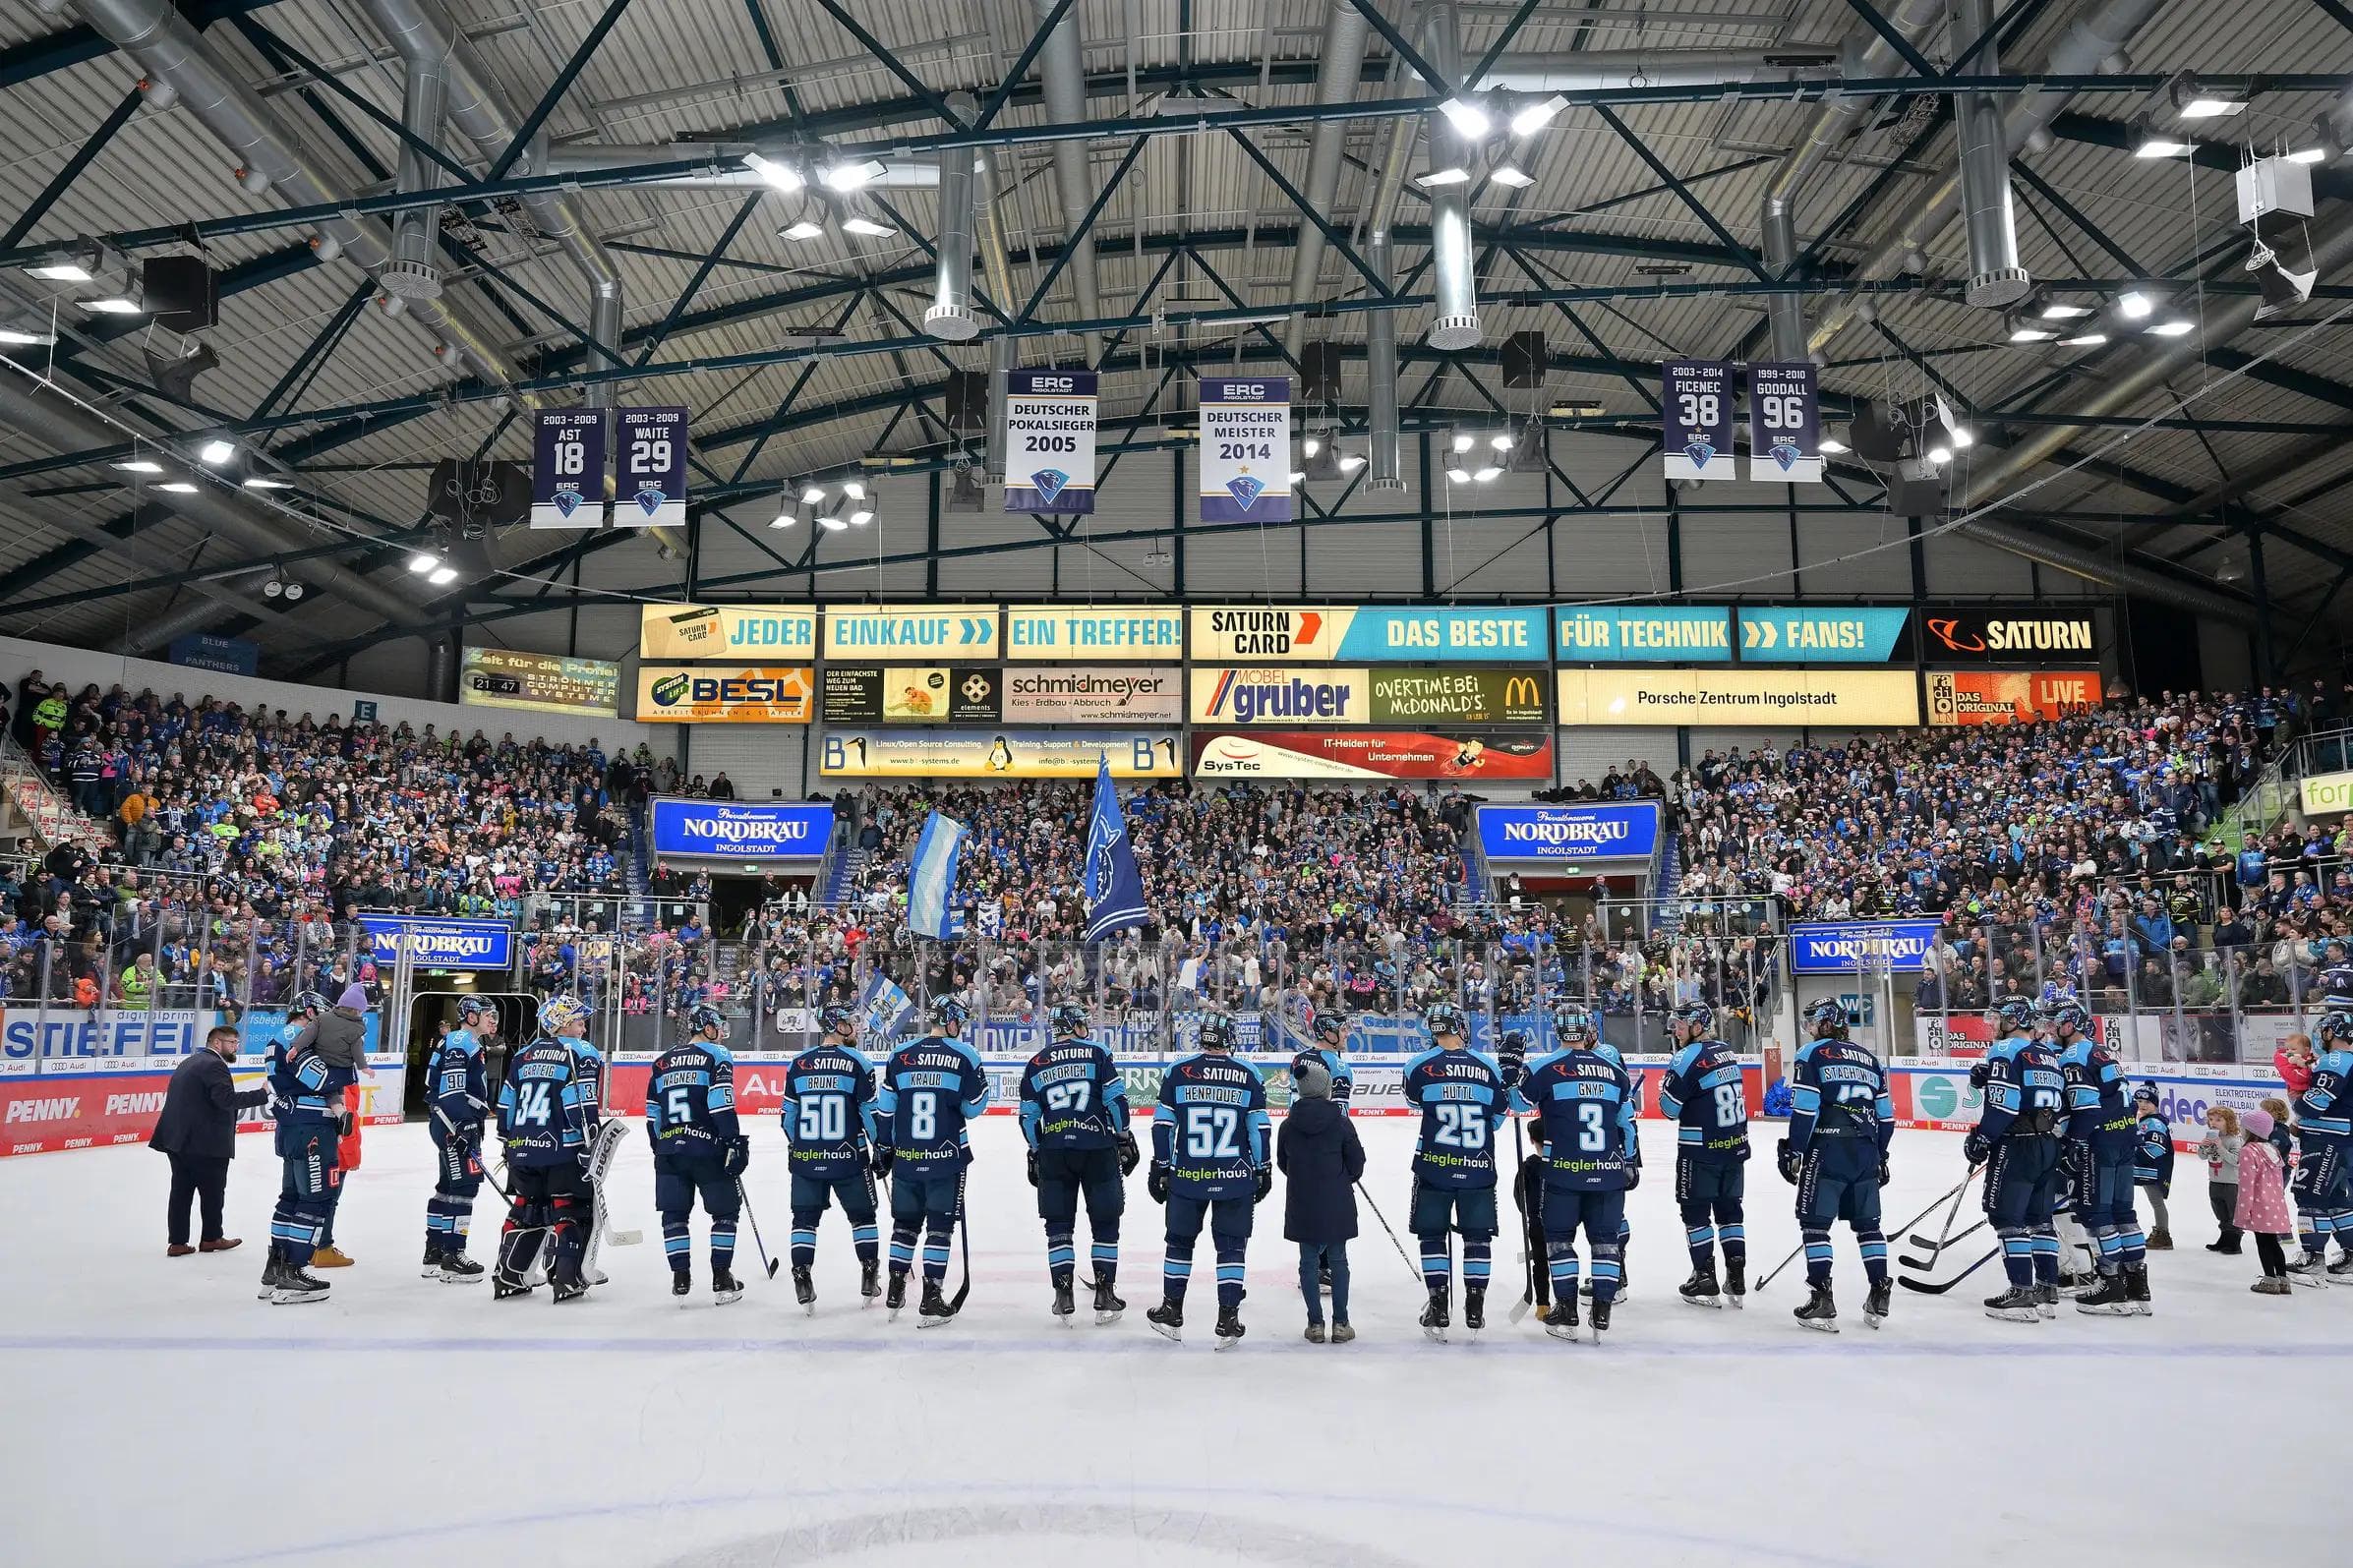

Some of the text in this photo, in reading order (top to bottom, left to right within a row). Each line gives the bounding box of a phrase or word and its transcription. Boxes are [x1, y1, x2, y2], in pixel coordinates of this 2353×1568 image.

[1031, 377, 1074, 388] ERC
[1223, 384, 1265, 395] ERC
[1676, 380, 1721, 393] FICENEC
[1756, 383, 1807, 395] GOODALL
[1014, 404, 1089, 416] DEUTSCHER
[1206, 412, 1283, 423] DEUTSCHER
[1678, 394, 1720, 427] 38
[1763, 396, 1804, 429] 96
[635, 427, 670, 439] WAITE
[1008, 419, 1095, 431] POKALSIEGER
[1213, 427, 1276, 438] MEISTER
[559, 429, 581, 440] AST
[1025, 436, 1077, 452] 2005
[1219, 443, 1271, 460] 2014
[554, 442, 584, 475] 18
[630, 440, 672, 474] 29
[1211, 611, 1290, 632] SATURN
[678, 623, 707, 637] SATURN
[731, 618, 1182, 645] JEDER EINKAUF EIN TREFFER!
[1386, 613, 1864, 649] DAS BESTE FÜR TECHNIK FANS!
[1987, 620, 2092, 649] SATURN
[201, 637, 229, 649] BLUE
[1235, 633, 1290, 654] CARD
[185, 657, 240, 672] PANTHERS
[507, 657, 534, 668] für
[537, 661, 561, 671] die
[527, 672, 616, 688] STRÖHMER
[657, 674, 684, 694] SYSTEM
[1237, 669, 1290, 684] MÖBEL
[526, 680, 616, 696] COMPUTER
[669, 685, 684, 698] LIFT
[692, 678, 802, 702] BESL
[1012, 674, 1164, 699] schmidmeyer
[2041, 680, 2086, 704] LIVE
[531, 689, 612, 703] SYSTEME
[1011, 698, 1111, 707] Kies Erdbau Abbruch
[1233, 678, 1351, 723] gruber
[1638, 691, 1838, 708] Porsche Zentrum Ingolstadt
[1956, 692, 1980, 702] DAS
[361, 703, 371, 719] E
[1957, 703, 2015, 713] ORIGINAL
[1081, 711, 1172, 722] www.schmidmeyer.net
[875, 739, 942, 749] Linux/Open Source
[1043, 740, 1072, 750] Support
[1082, 740, 1129, 750] Development
[1324, 738, 1386, 748] IT-Helden für
[1369, 752, 1435, 762] Unternehmen
[1204, 761, 1261, 773] SysTec
[1536, 810, 1597, 822] Privatbrauerei
[682, 818, 809, 842] NORDBRÄU
[1504, 821, 1629, 844] NORDBRÄU
[716, 843, 777, 853] INGOLSTADT
[1537, 845, 1598, 854] INGOLSTADT
[533, 1049, 567, 1062] SATURN
[916, 1053, 962, 1070] SATURN
[1050, 1048, 1093, 1062] SATURN
[813, 1058, 854, 1073] SATURN
[2160, 1066, 2176, 1074] Audi
[2212, 1068, 2228, 1076] Audi
[1038, 1065, 1088, 1083] FRIEDRICH
[1203, 1067, 1249, 1083] SATURN
[1445, 1065, 1490, 1083] SATURN
[807, 1076, 839, 1090] BRUNE
[1578, 1081, 1605, 1097] GNYP
[724, 1087, 734, 1104] 5
[1184, 1086, 1243, 1104] HENRIQUEZ
[1441, 1083, 1475, 1101] HÜTTL
[2215, 1089, 2272, 1099] ELEKTROTECHNIK
[6, 1097, 81, 1124] PENNY.
[515, 1081, 551, 1127] 34
[668, 1087, 692, 1125] 5
[2216, 1101, 2255, 1110] METALLBAU
[798, 1094, 847, 1140] 50
[911, 1091, 936, 1140] 8
[1187, 1106, 1241, 1158] 52
[1434, 1103, 1486, 1149] 25
[1577, 1103, 1607, 1152] 3
[64, 1137, 92, 1148] PENNY.
[113, 1132, 140, 1144] PENNY.
[12, 1142, 43, 1154] PENNY.
[446, 1145, 462, 1181] SATURN
[1423, 1152, 1489, 1170] zieglerhaus
[1553, 1156, 1622, 1174] zieglerhaus
[309, 1154, 323, 1193] SATURN
[1177, 1167, 1248, 1182] zieglerhaus
[1988, 1143, 2008, 1209] partyrent.com
